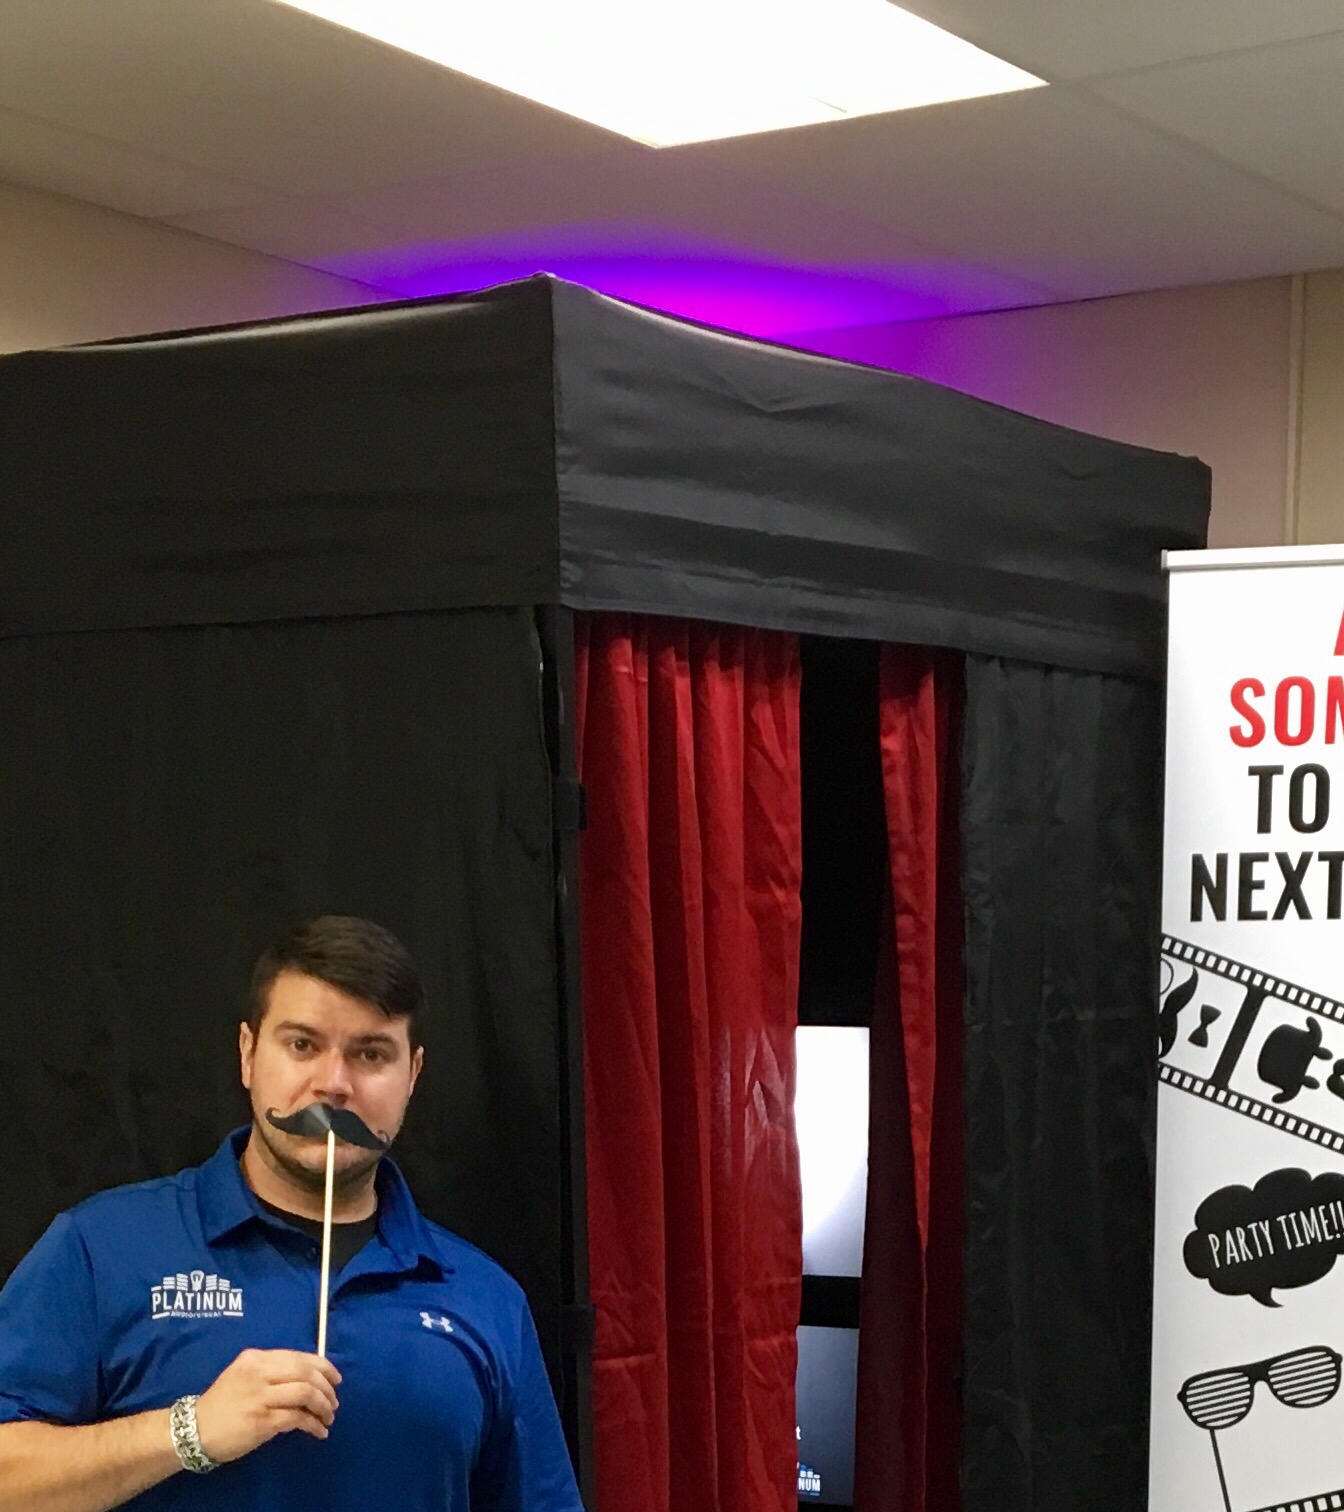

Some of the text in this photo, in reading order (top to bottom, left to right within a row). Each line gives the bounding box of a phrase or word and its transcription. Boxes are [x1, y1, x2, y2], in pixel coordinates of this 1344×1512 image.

[1248, 763, 1330, 834] TO
[1208, 1219, 1275, 1269] PARTY
[152, 1291, 243, 1312] PLATINUM
